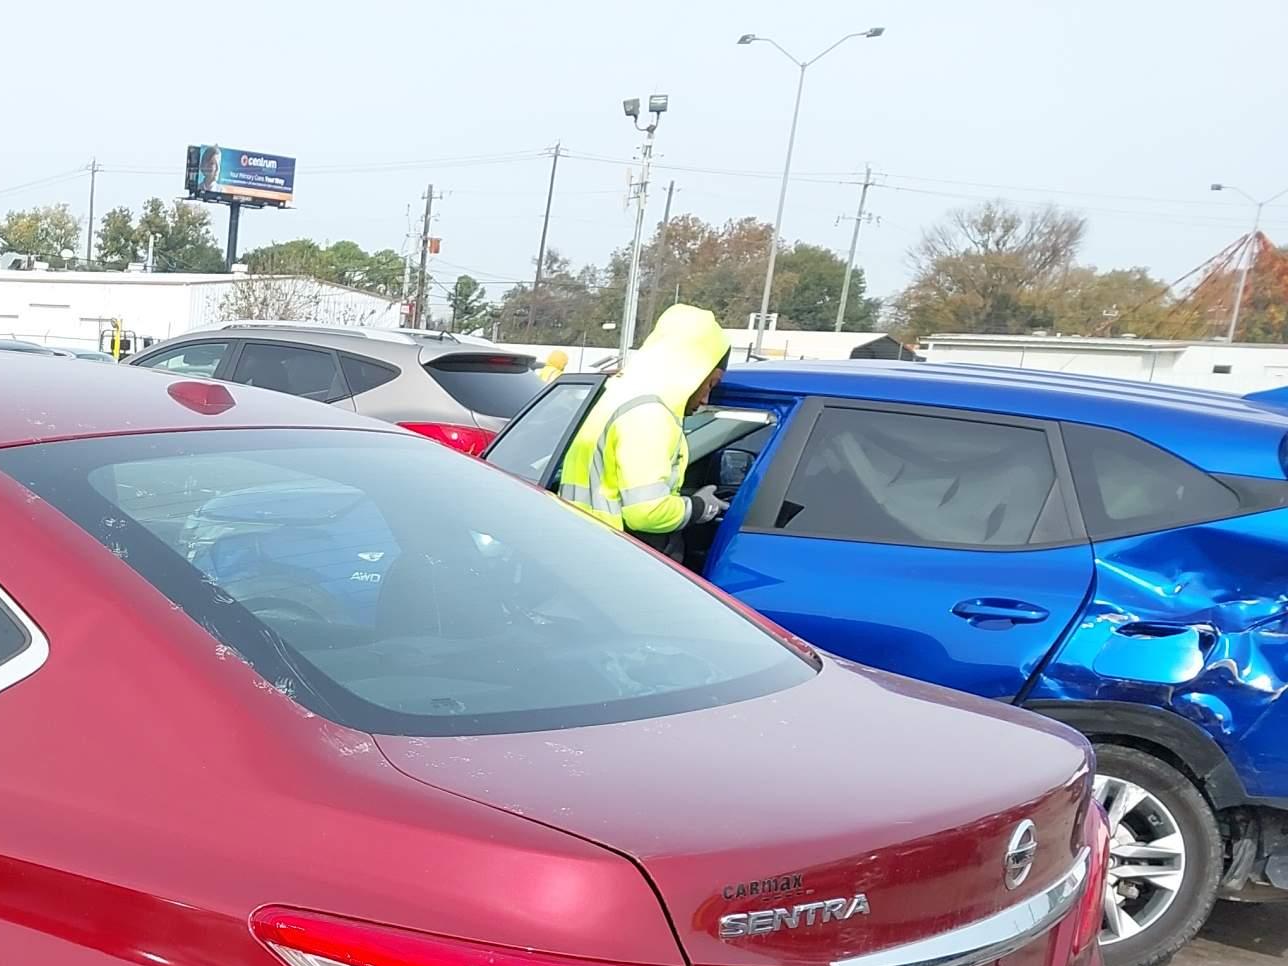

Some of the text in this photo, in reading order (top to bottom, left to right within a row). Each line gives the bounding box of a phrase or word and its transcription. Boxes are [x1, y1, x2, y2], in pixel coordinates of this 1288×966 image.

[247, 157, 277, 169] centrum
[350, 571, 381, 582] AWD
[719, 893, 870, 938] SENTRA
